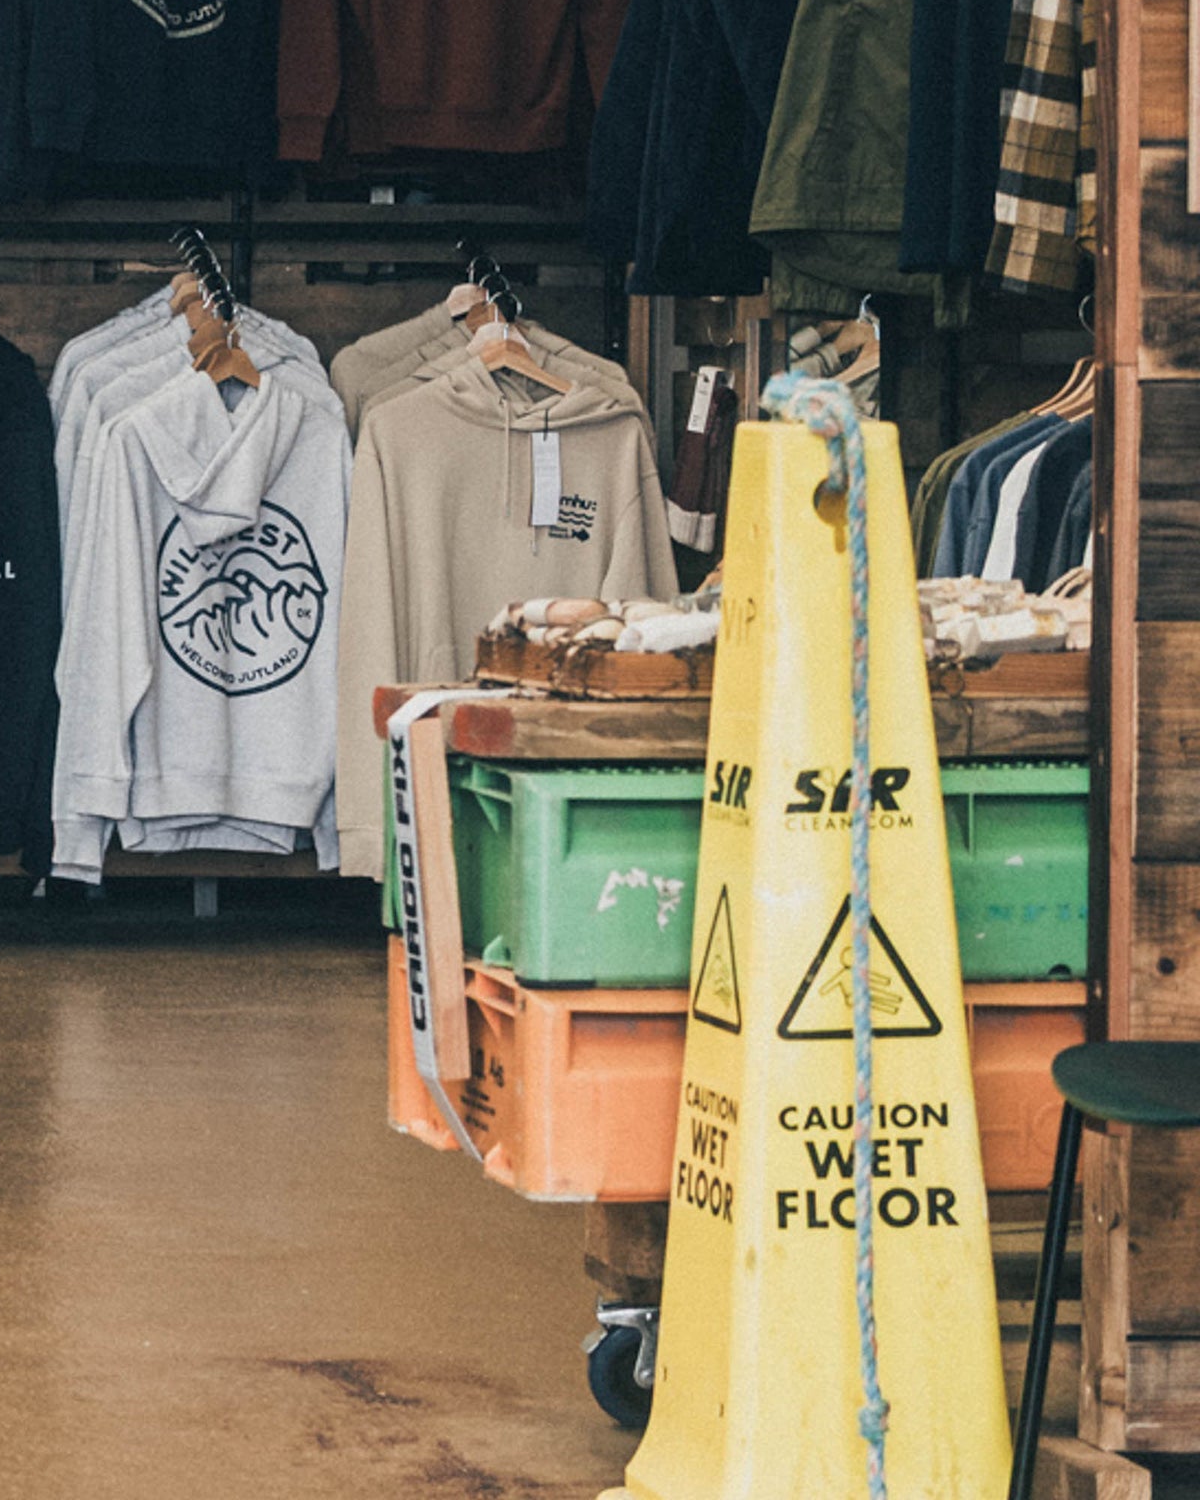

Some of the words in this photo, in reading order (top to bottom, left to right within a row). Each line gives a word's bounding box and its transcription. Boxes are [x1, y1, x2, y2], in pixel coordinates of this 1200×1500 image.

[560, 494, 597, 512] mhu:
[238, 647, 299, 683] JUTLAND
[391, 734, 410, 826] FIX
[710, 761, 753, 809] SIR
[785, 767, 911, 812] SIR
[400, 842, 427, 1032] CARGO
[686, 1082, 739, 1125] CAUTION
[779, 1103, 949, 1130] CAUION
[692, 1117, 729, 1169] WET
[805, 1138, 923, 1179] WET
[677, 1161, 734, 1224] FLOOR
[776, 1187, 960, 1229] FLOOR
